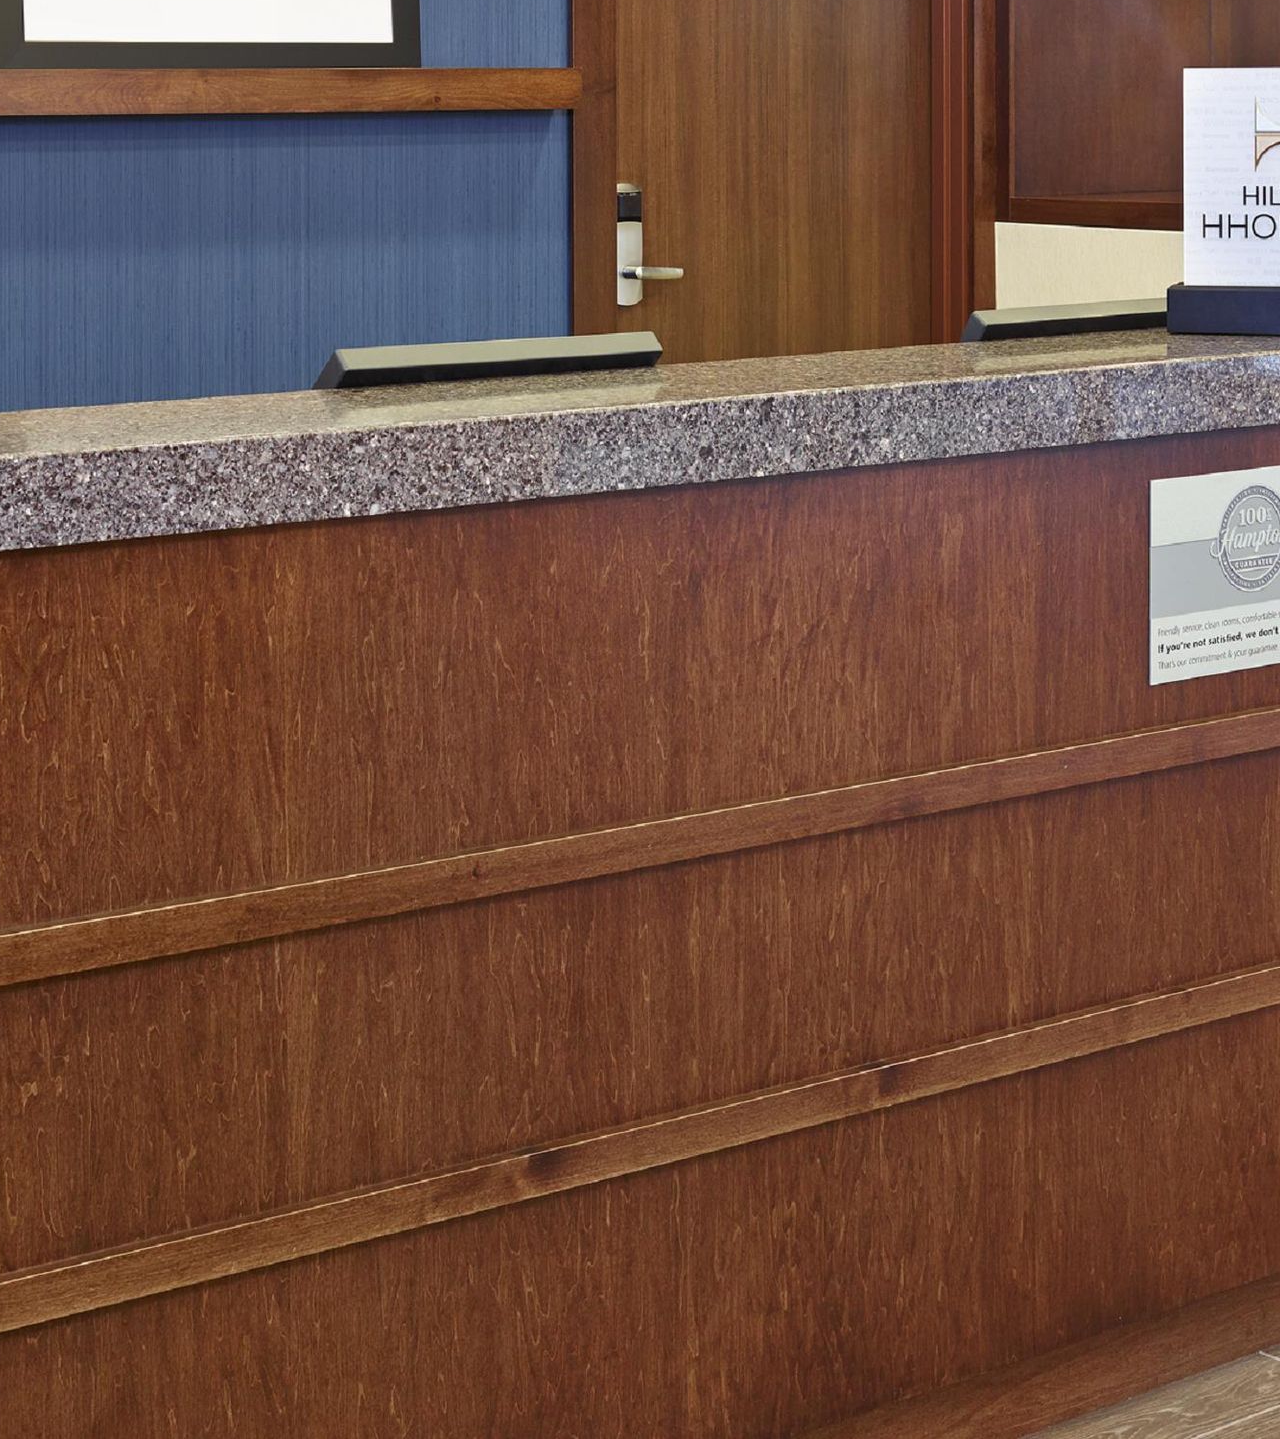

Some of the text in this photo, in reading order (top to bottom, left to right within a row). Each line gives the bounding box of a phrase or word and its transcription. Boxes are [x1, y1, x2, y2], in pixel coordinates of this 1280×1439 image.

[1158, 644, 1164, 654] If
[1193, 638, 1206, 648] not
[1209, 631, 1243, 645] satisfied,
[1245, 631, 1256, 639] we
[1258, 626, 1279, 637] don't
